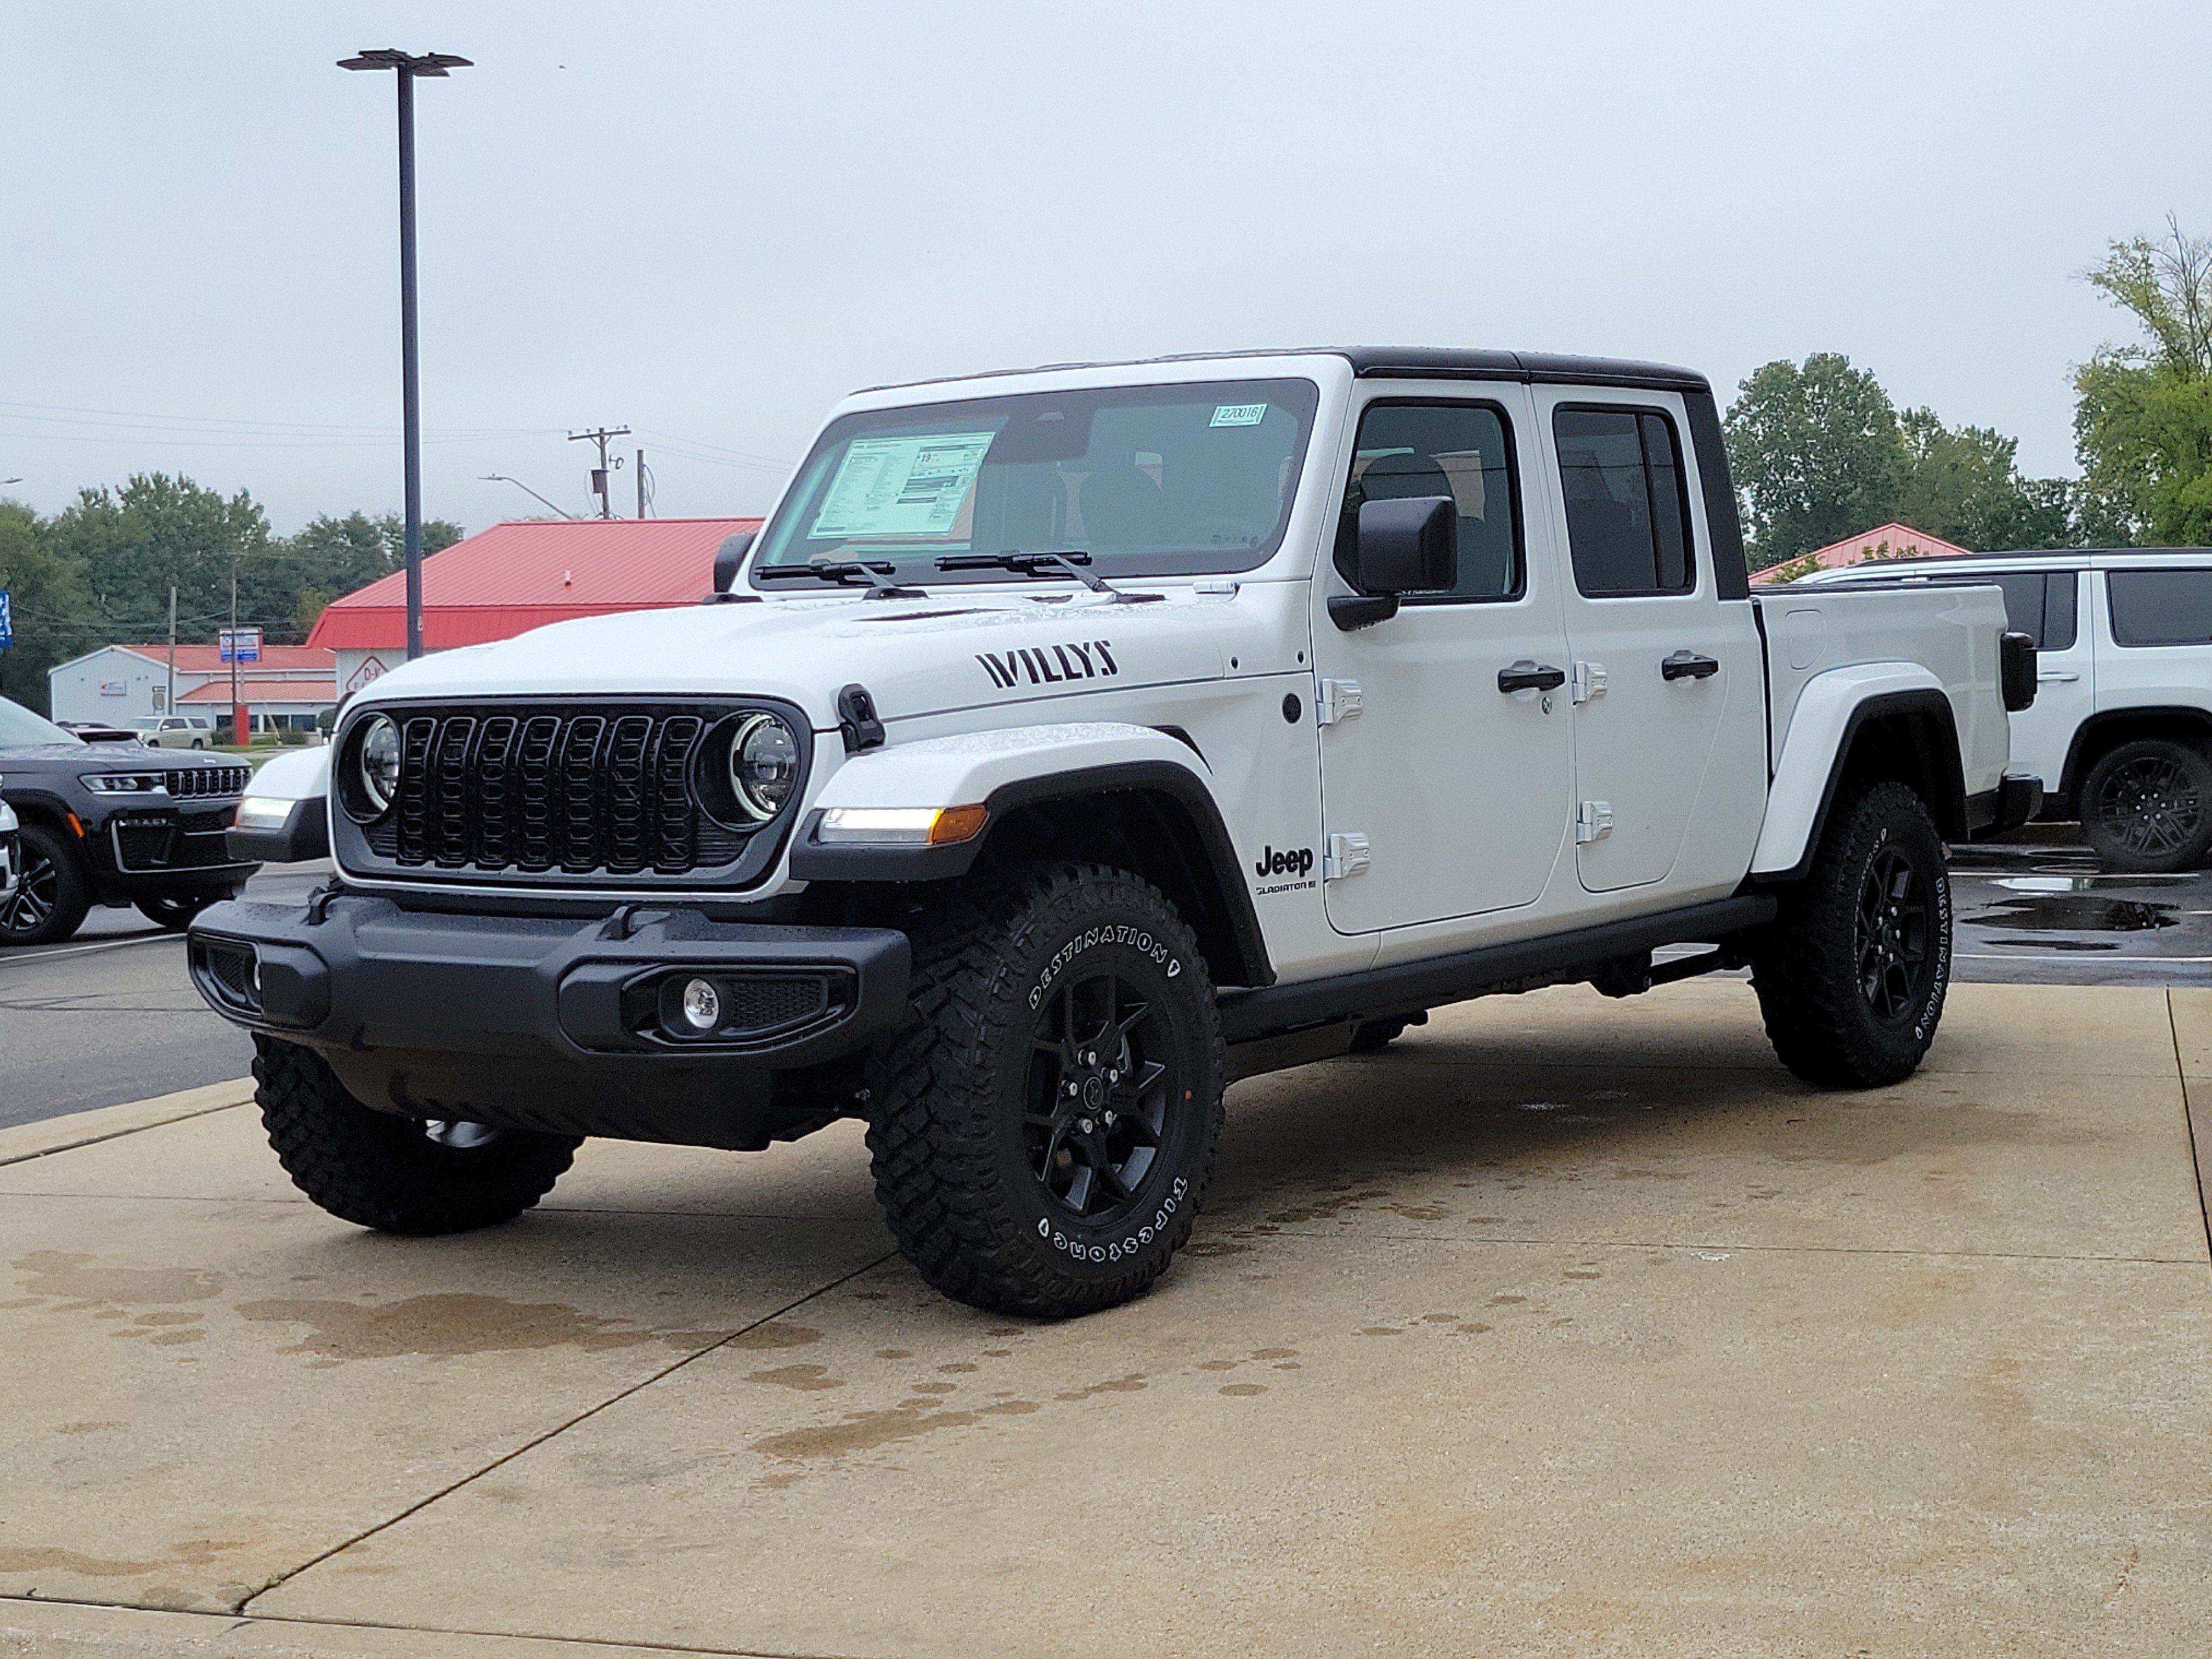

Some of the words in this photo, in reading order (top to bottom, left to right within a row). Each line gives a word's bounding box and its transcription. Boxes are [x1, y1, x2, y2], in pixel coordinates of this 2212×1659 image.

[1221, 407, 1259, 418] 270016
[974, 640, 1118, 689] WILLYS
[1256, 845, 1313, 878] Jeep
[1256, 882, 1307, 895] GLADIATOR
[1029, 926, 1167, 1010] DESTINATION
